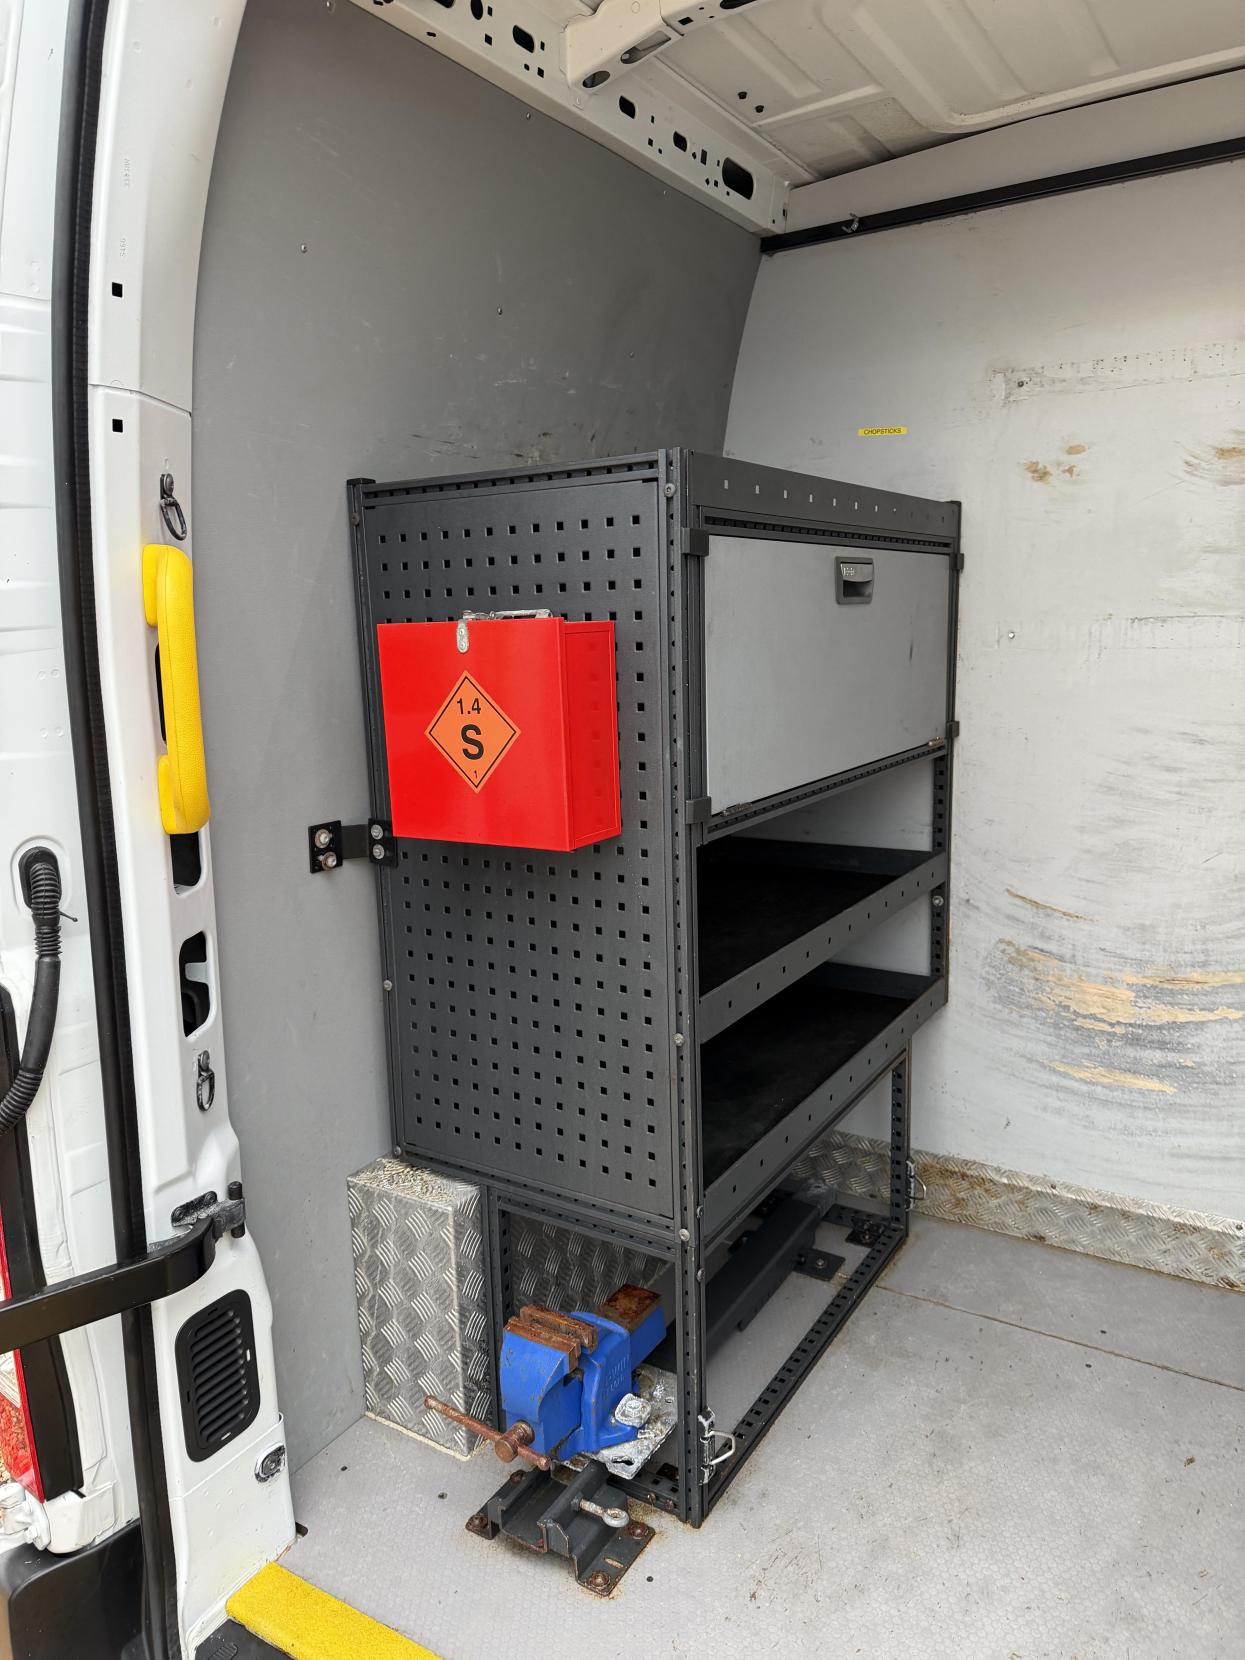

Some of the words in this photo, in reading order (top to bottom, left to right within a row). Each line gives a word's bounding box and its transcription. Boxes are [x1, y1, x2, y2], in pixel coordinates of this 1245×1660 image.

[863, 427, 902, 435] CHOPSTICKS
[457, 698, 481, 715] 1.4
[461, 724, 485, 760] S
[473, 770, 478, 779] 1
